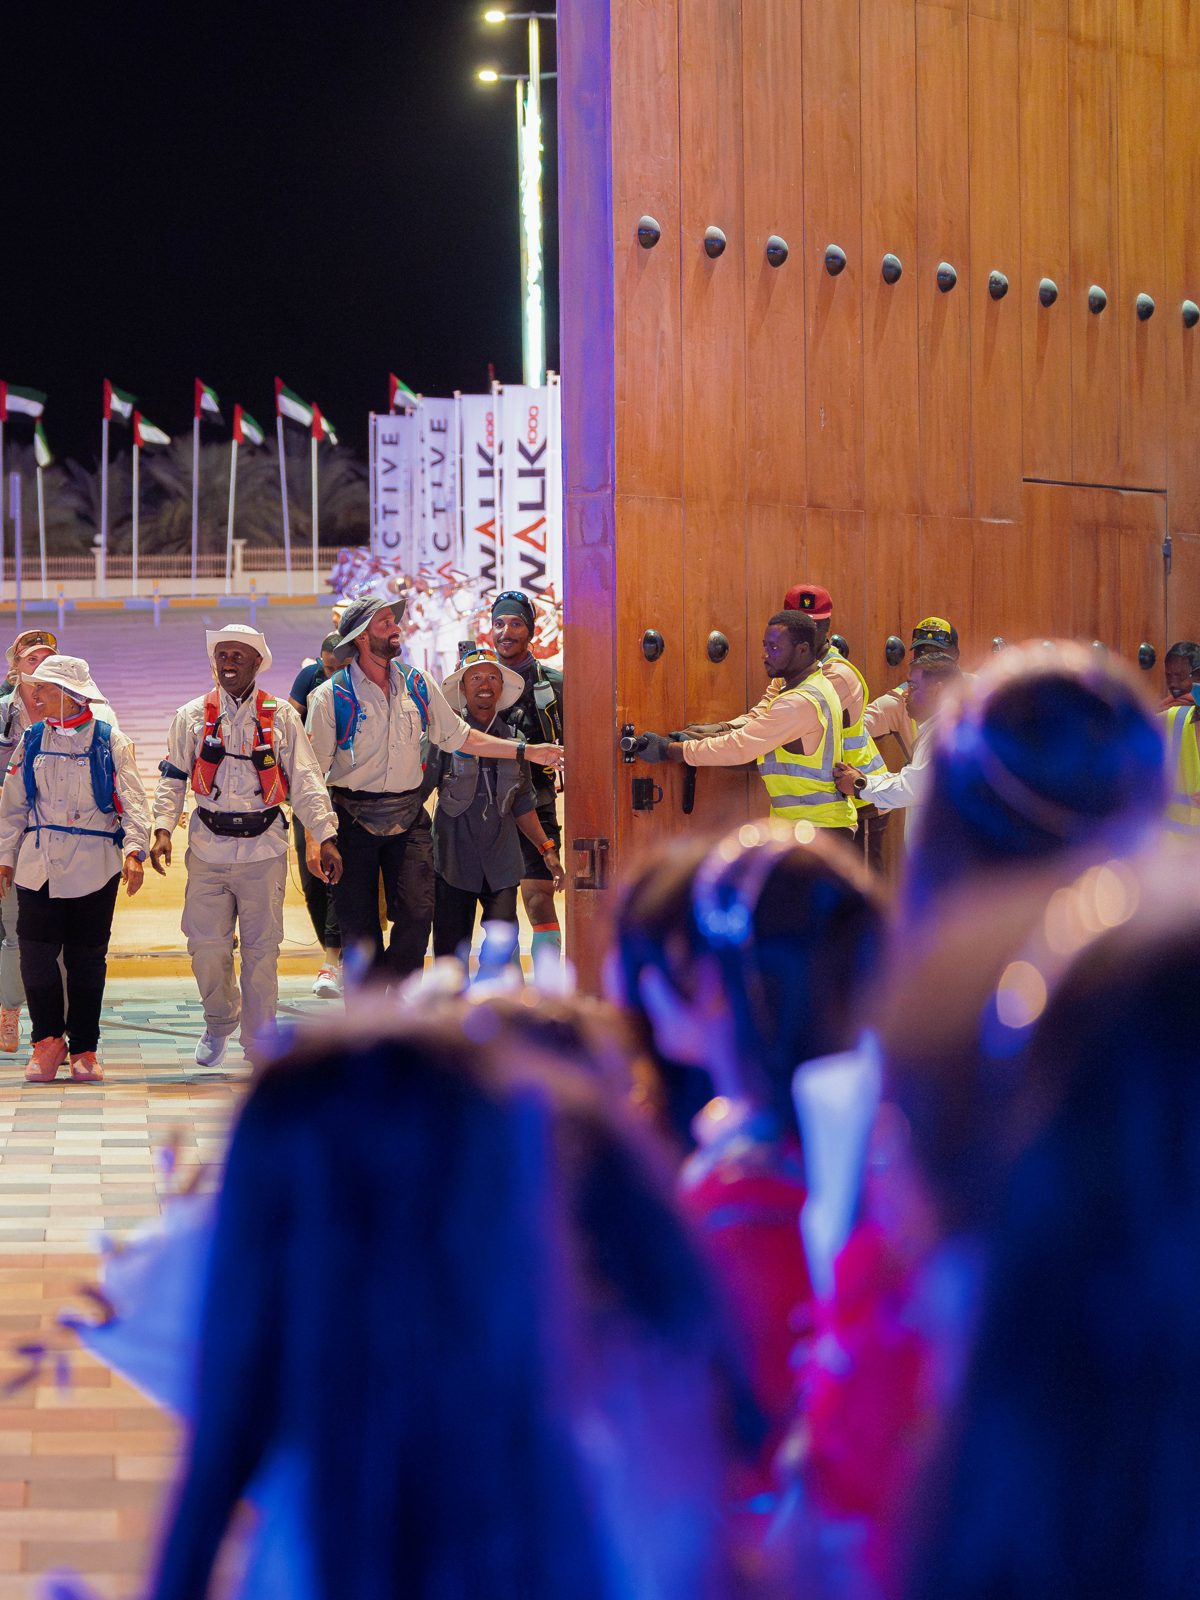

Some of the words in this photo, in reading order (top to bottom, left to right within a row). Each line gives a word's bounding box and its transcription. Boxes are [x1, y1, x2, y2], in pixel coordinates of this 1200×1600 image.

[528, 405, 539, 444] 1000
[382, 431, 401, 570] CTIVE
[430, 418, 455, 583] ACTIVE
[512, 438, 547, 594] WALK
